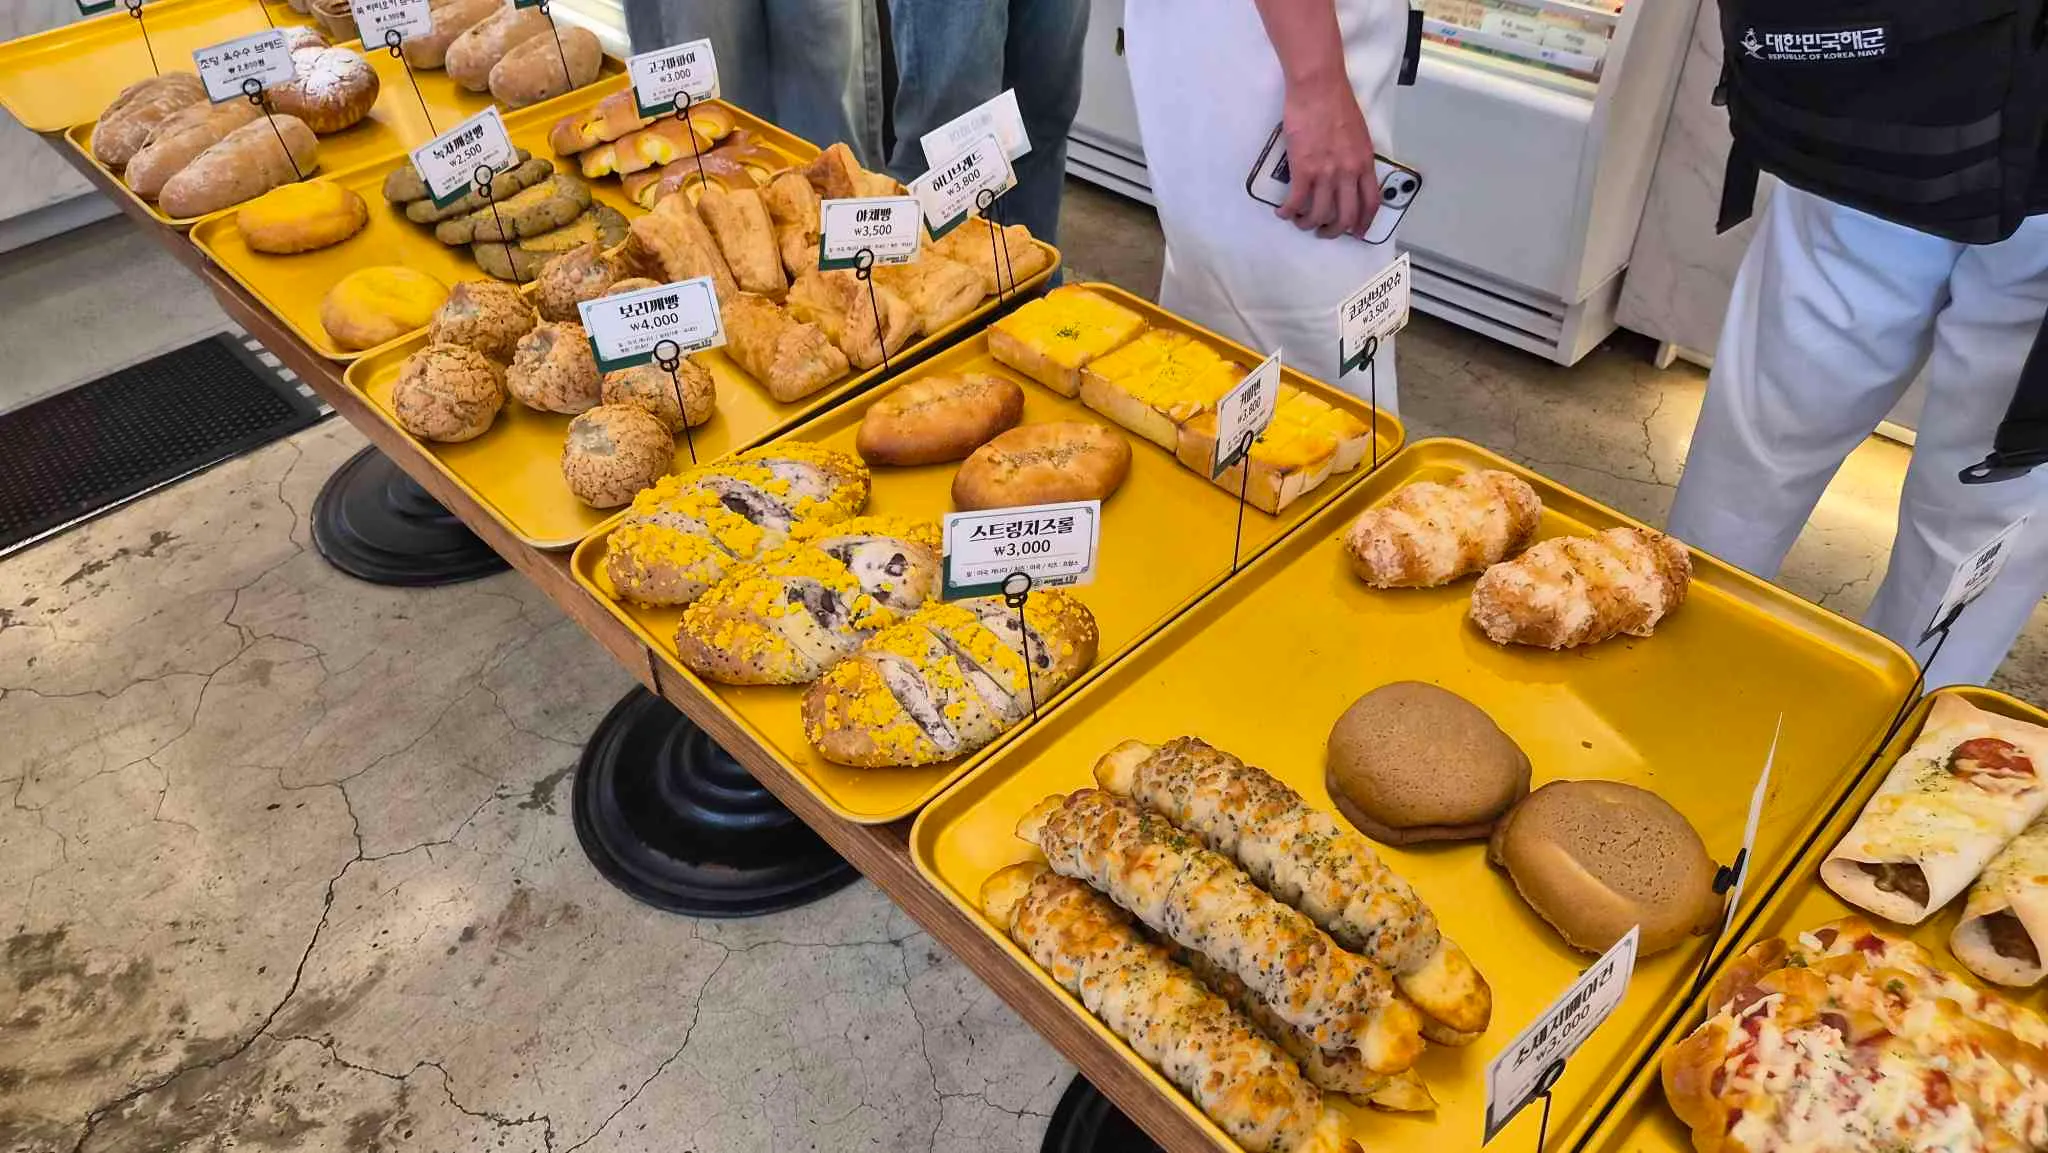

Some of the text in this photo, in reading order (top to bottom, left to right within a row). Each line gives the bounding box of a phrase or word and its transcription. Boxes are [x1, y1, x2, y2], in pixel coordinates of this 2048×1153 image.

[1765, 28, 1886, 53] 대한민국해군
[648, 51, 697, 75] 고구마파이
[1767, 48, 1886, 61] REPUBLIC OF KOREA NAVY
[433, 123, 485, 160] 녹차깨찰빵
[932, 150, 984, 192] 허니브레드
[856, 207, 892, 223] 야채빵
[619, 293, 680, 320] 보리깨빵
[1348, 271, 1401, 322] 코코넛브리오슈
[968, 515, 1076, 542] 스트링치즈롤
